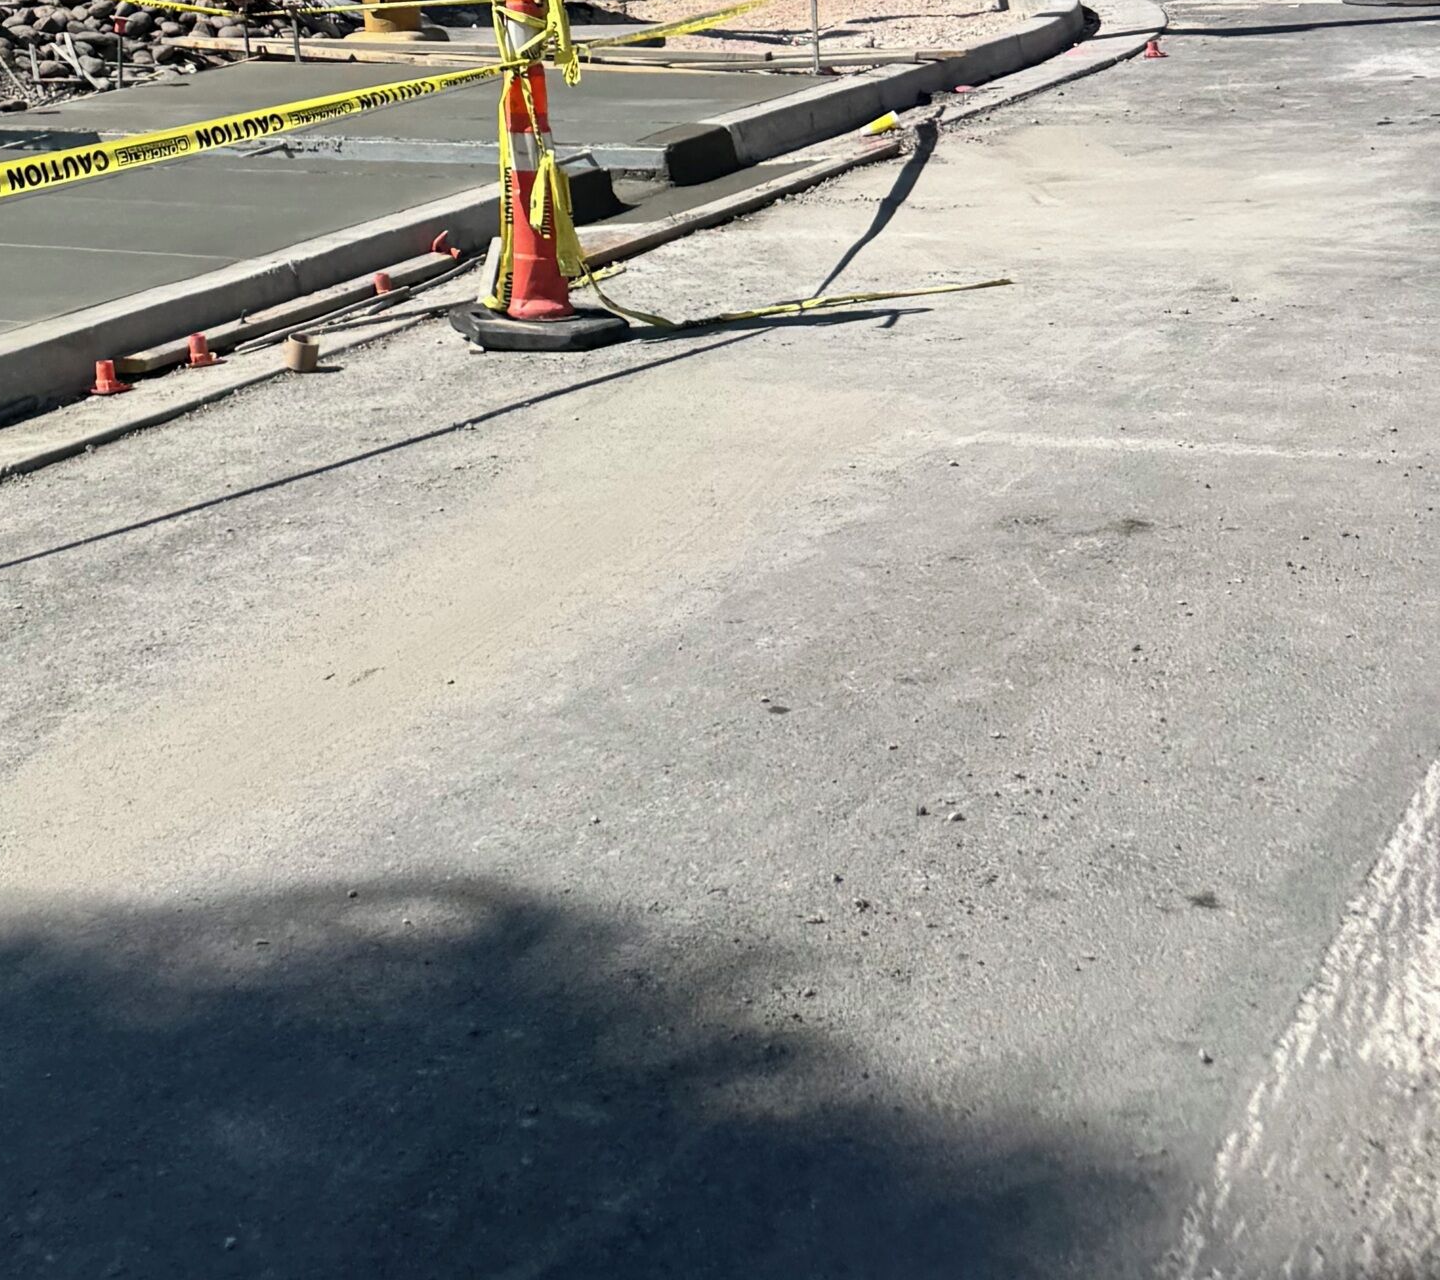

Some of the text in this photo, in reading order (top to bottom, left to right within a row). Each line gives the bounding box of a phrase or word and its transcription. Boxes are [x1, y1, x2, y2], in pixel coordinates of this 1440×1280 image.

[196, 113, 284, 149] CAUTION
[114, 135, 191, 167] CONCRETE
[6, 149, 109, 191] CAUTION
